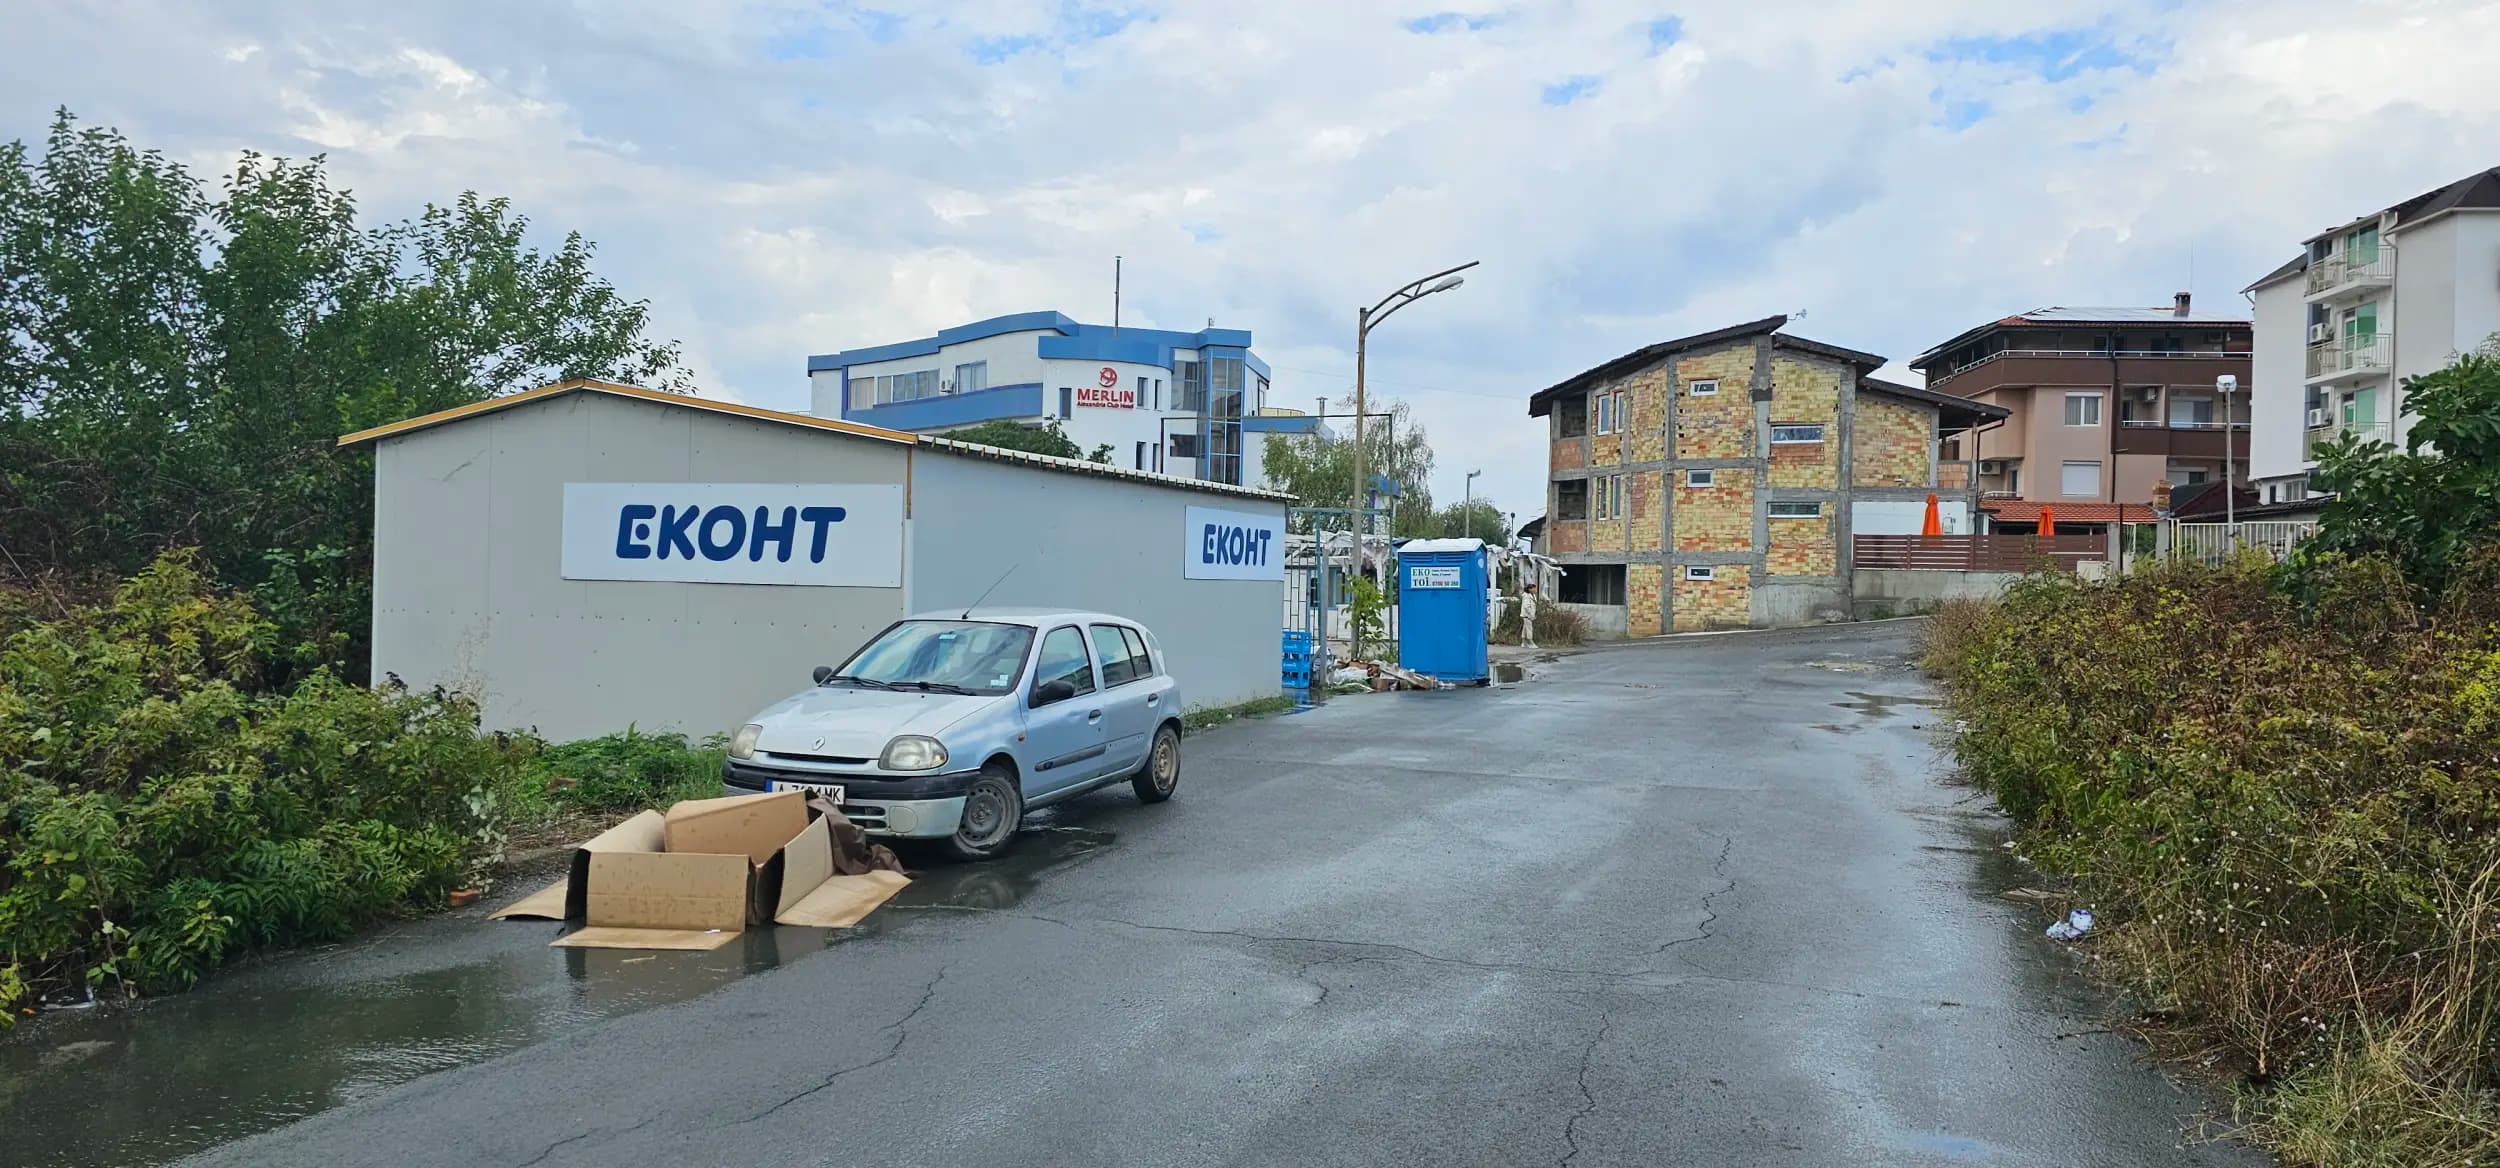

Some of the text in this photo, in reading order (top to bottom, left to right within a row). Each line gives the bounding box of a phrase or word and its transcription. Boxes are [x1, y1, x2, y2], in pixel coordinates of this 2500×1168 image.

[1077, 388, 1134, 403] MERLIN
[616, 504, 847, 564] ЕКОНТ
[1202, 523, 1271, 567] ЕКОНТ
